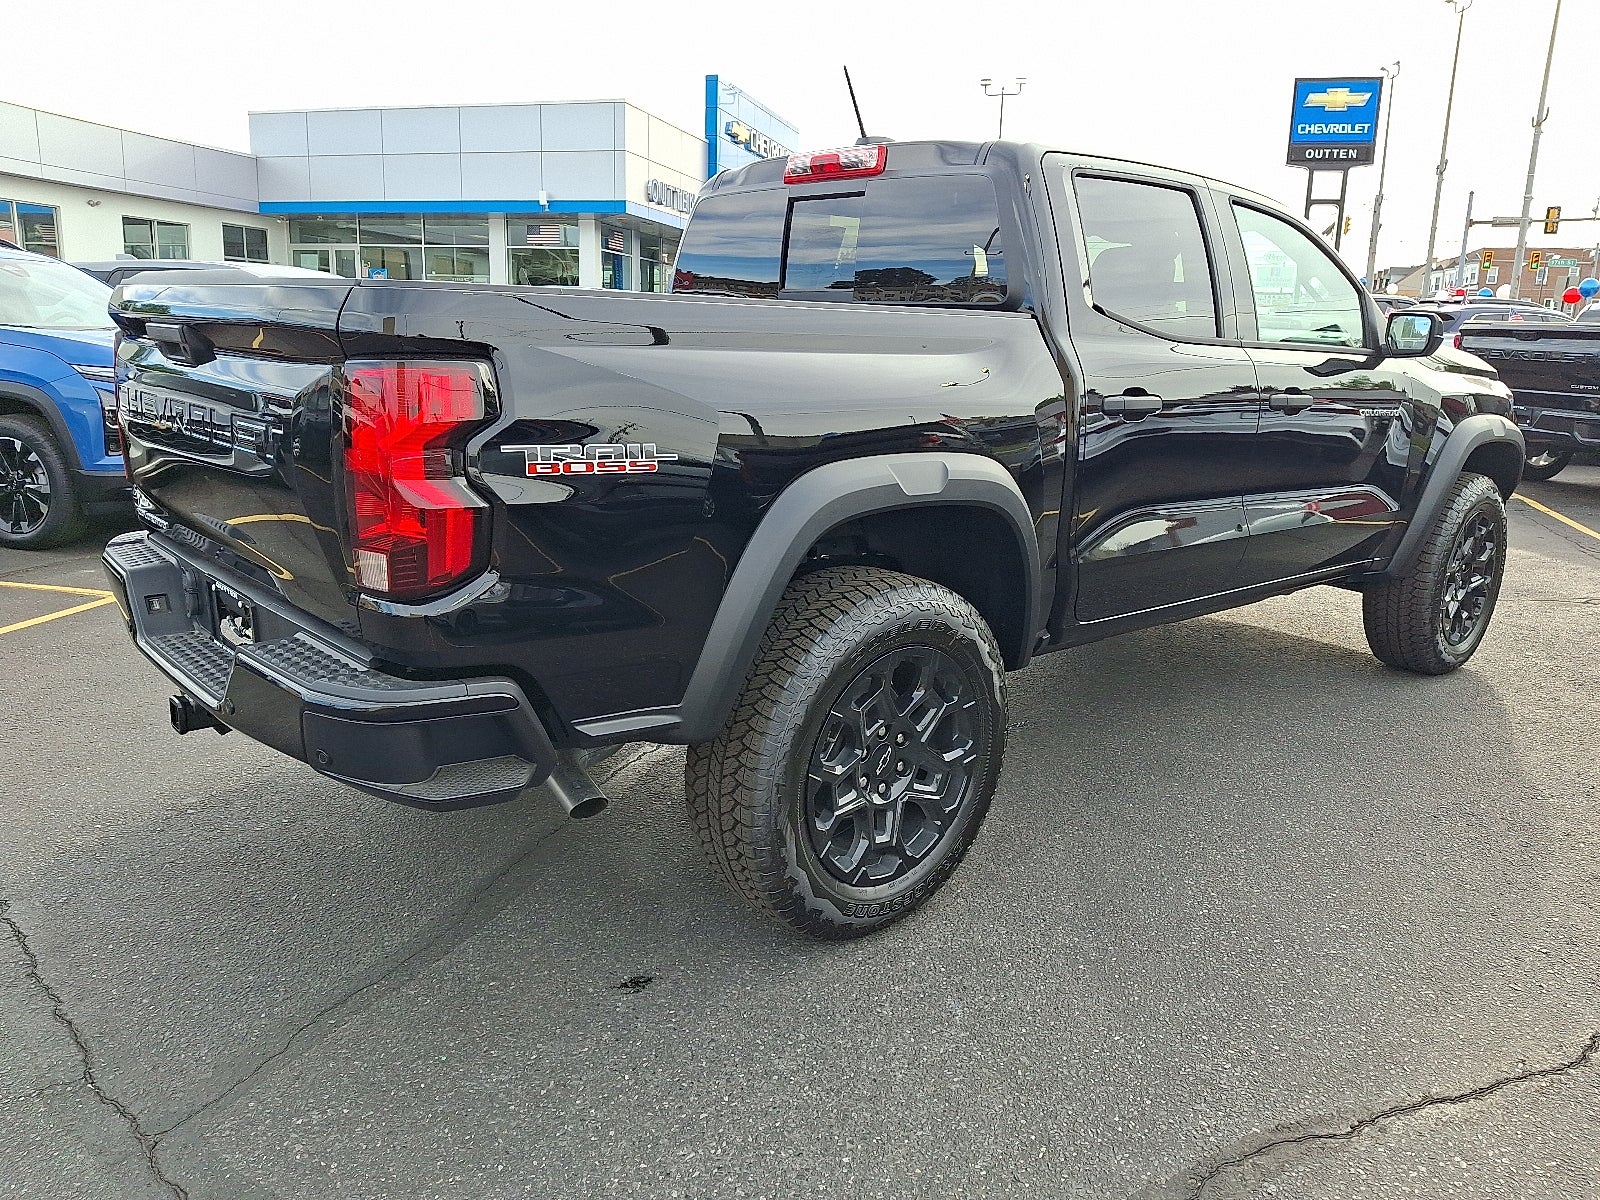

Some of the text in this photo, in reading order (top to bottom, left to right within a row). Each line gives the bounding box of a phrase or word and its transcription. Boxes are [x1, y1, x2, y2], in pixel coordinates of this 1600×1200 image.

[1297, 123, 1371, 134] CHEVROLET
[1305, 148, 1358, 159] OUTTEN
[118, 383, 283, 460] CHEVROLET
[500, 443, 678, 463] TRAIL
[525, 459, 659, 477] BOSS
